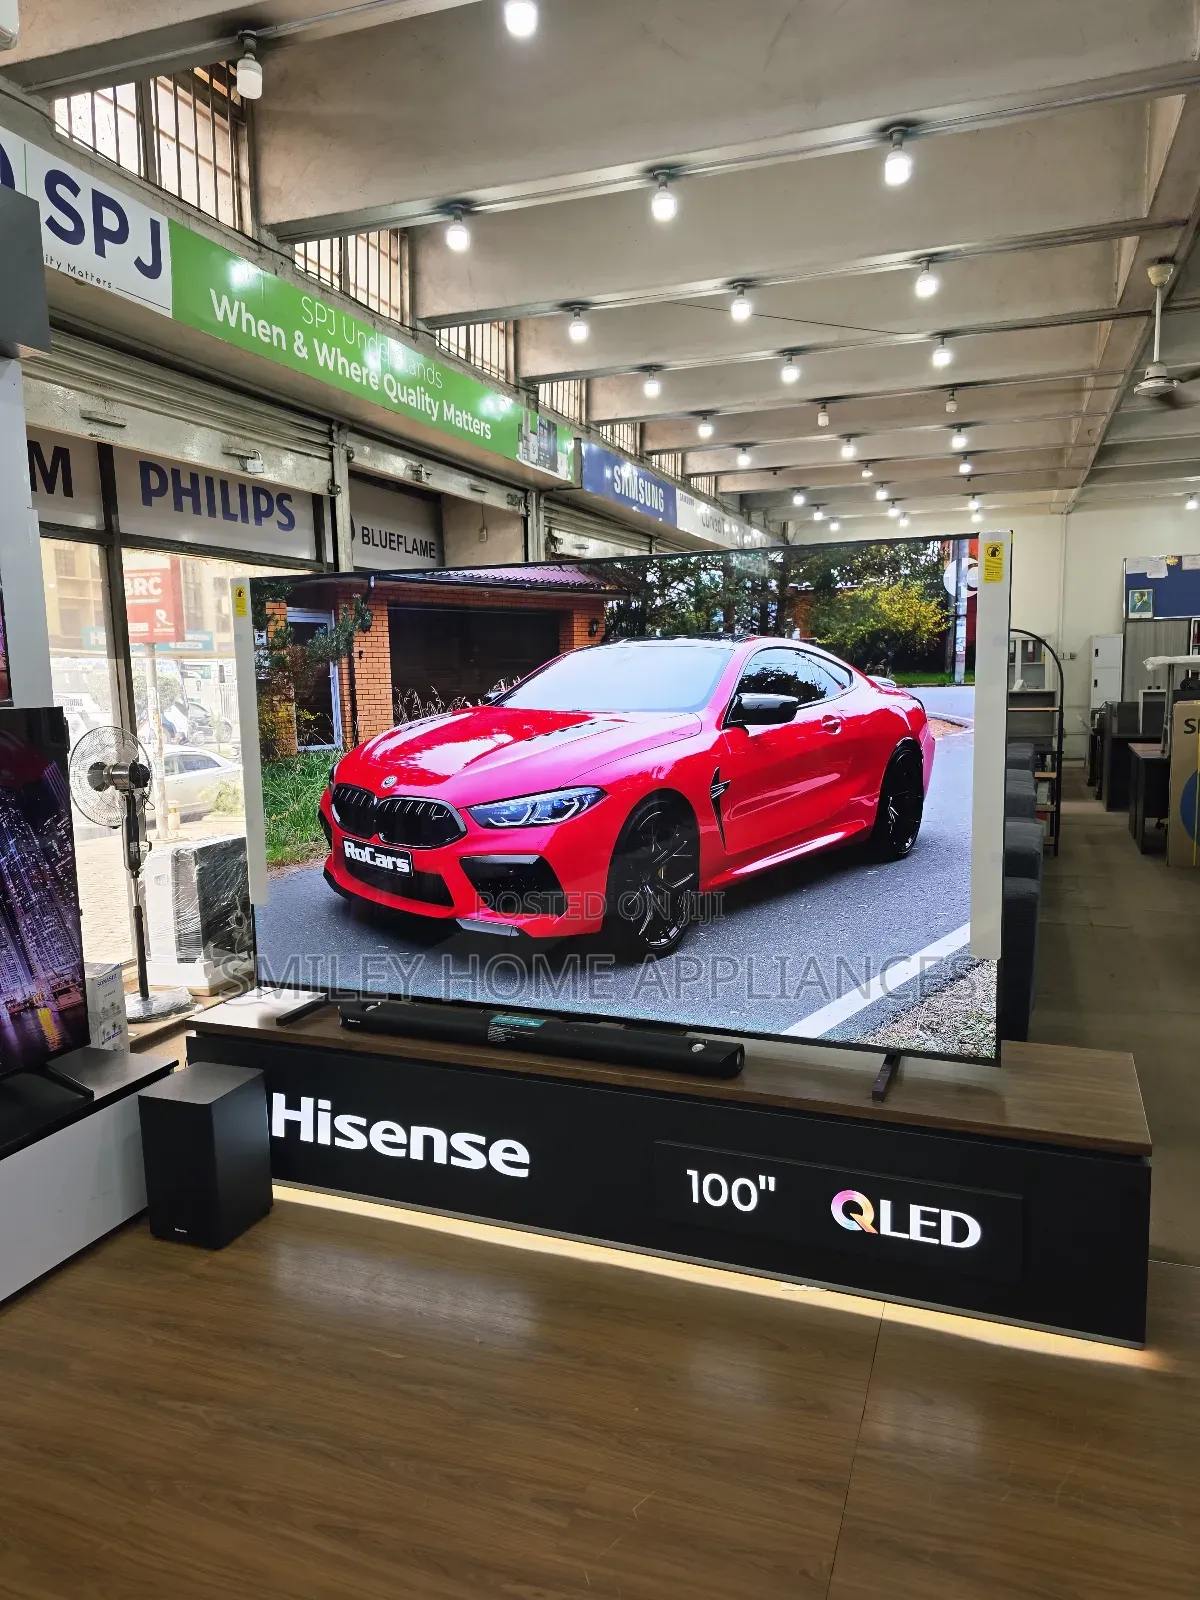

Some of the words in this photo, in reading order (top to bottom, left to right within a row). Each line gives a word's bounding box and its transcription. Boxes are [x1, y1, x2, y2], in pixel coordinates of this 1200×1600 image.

[44, 169, 163, 280] SPJ
[67, 263, 112, 289] Matters
[301, 296, 336, 336] SPJ
[209, 288, 287, 351] When
[293, 330, 309, 360] &
[313, 337, 379, 391] Where
[383, 373, 441, 422] Quality
[443, 399, 492, 440] Matters
[26, 439, 74, 499] M
[139, 460, 296, 532] PHILIPS
[613, 465, 665, 513] SAMSUNG
[361, 525, 436, 559] BLUEFLAME
[343, 840, 410, 873] RoCars
[271, 1092, 531, 1179] Hisense
[686, 1169, 776, 1213] 100"
[830, 1189, 982, 1249] QLED
